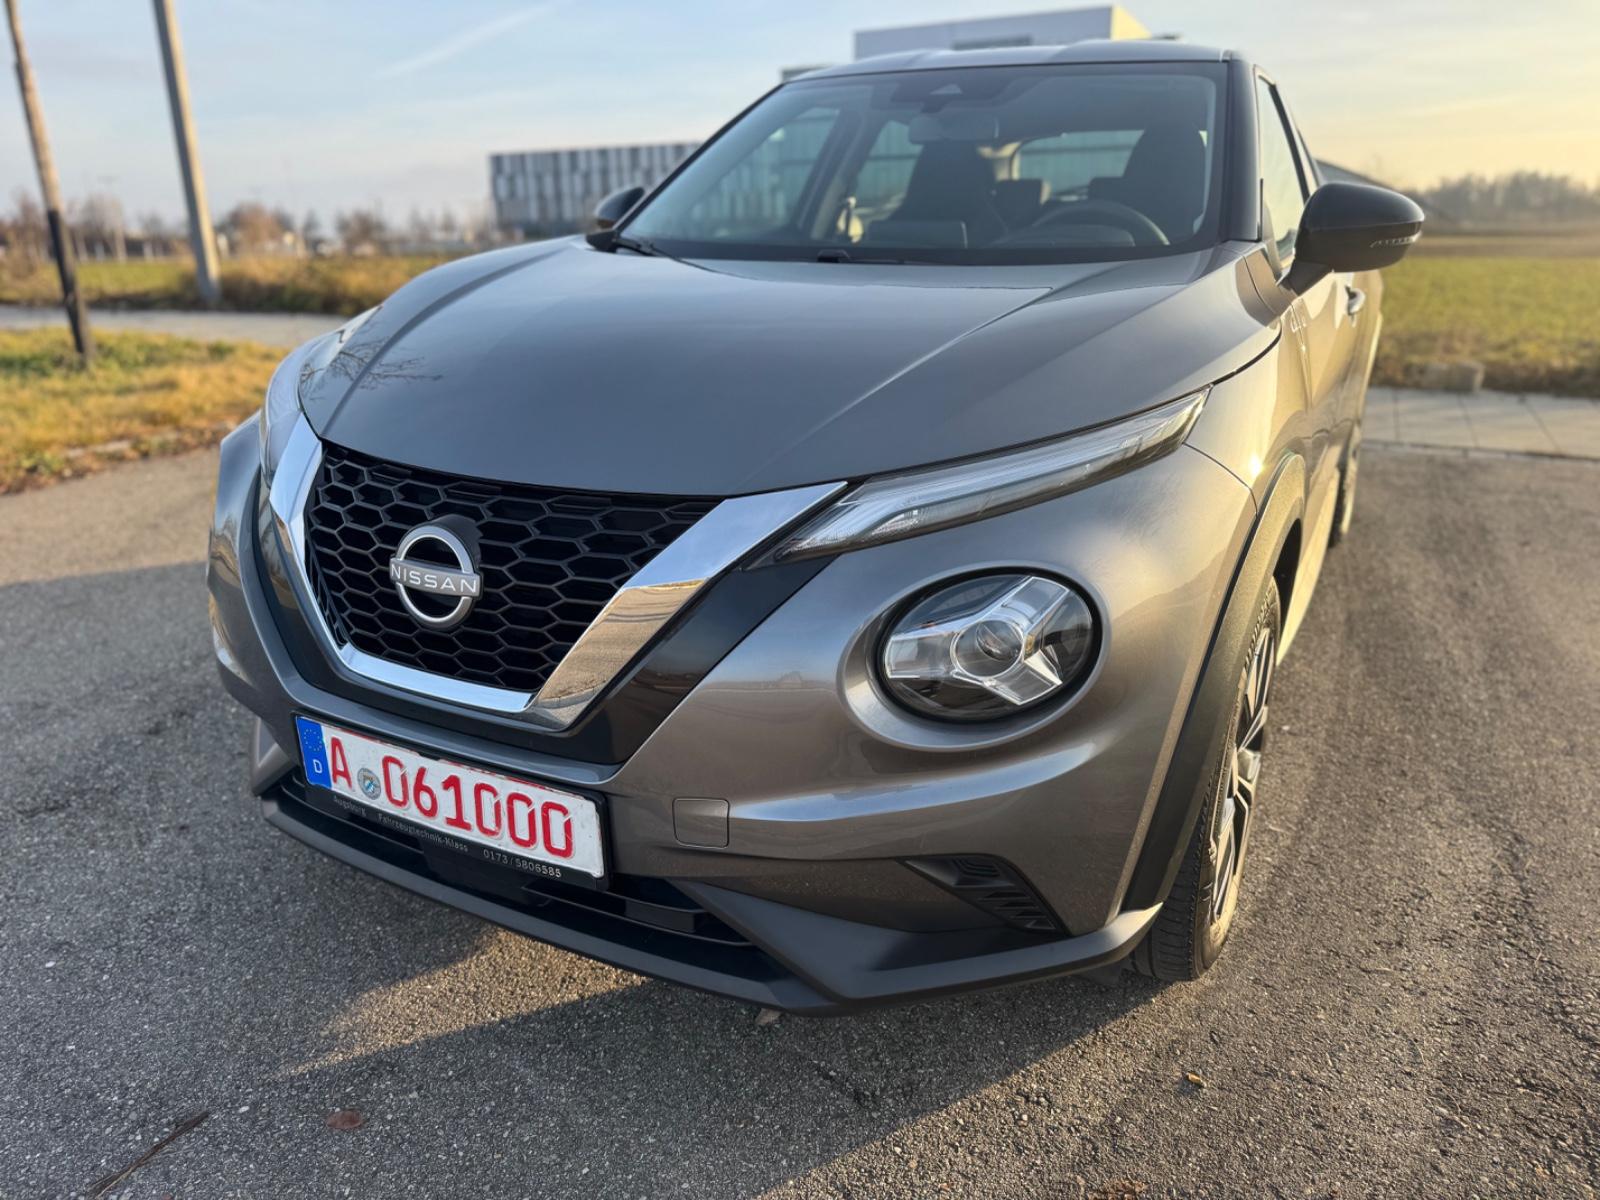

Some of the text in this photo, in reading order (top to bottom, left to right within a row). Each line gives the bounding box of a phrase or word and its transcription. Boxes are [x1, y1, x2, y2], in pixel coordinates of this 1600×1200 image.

[391, 564, 477, 593] NISSAN
[313, 759, 323, 774] D
[331, 736, 352, 789] A
[382, 755, 574, 859] 061000
